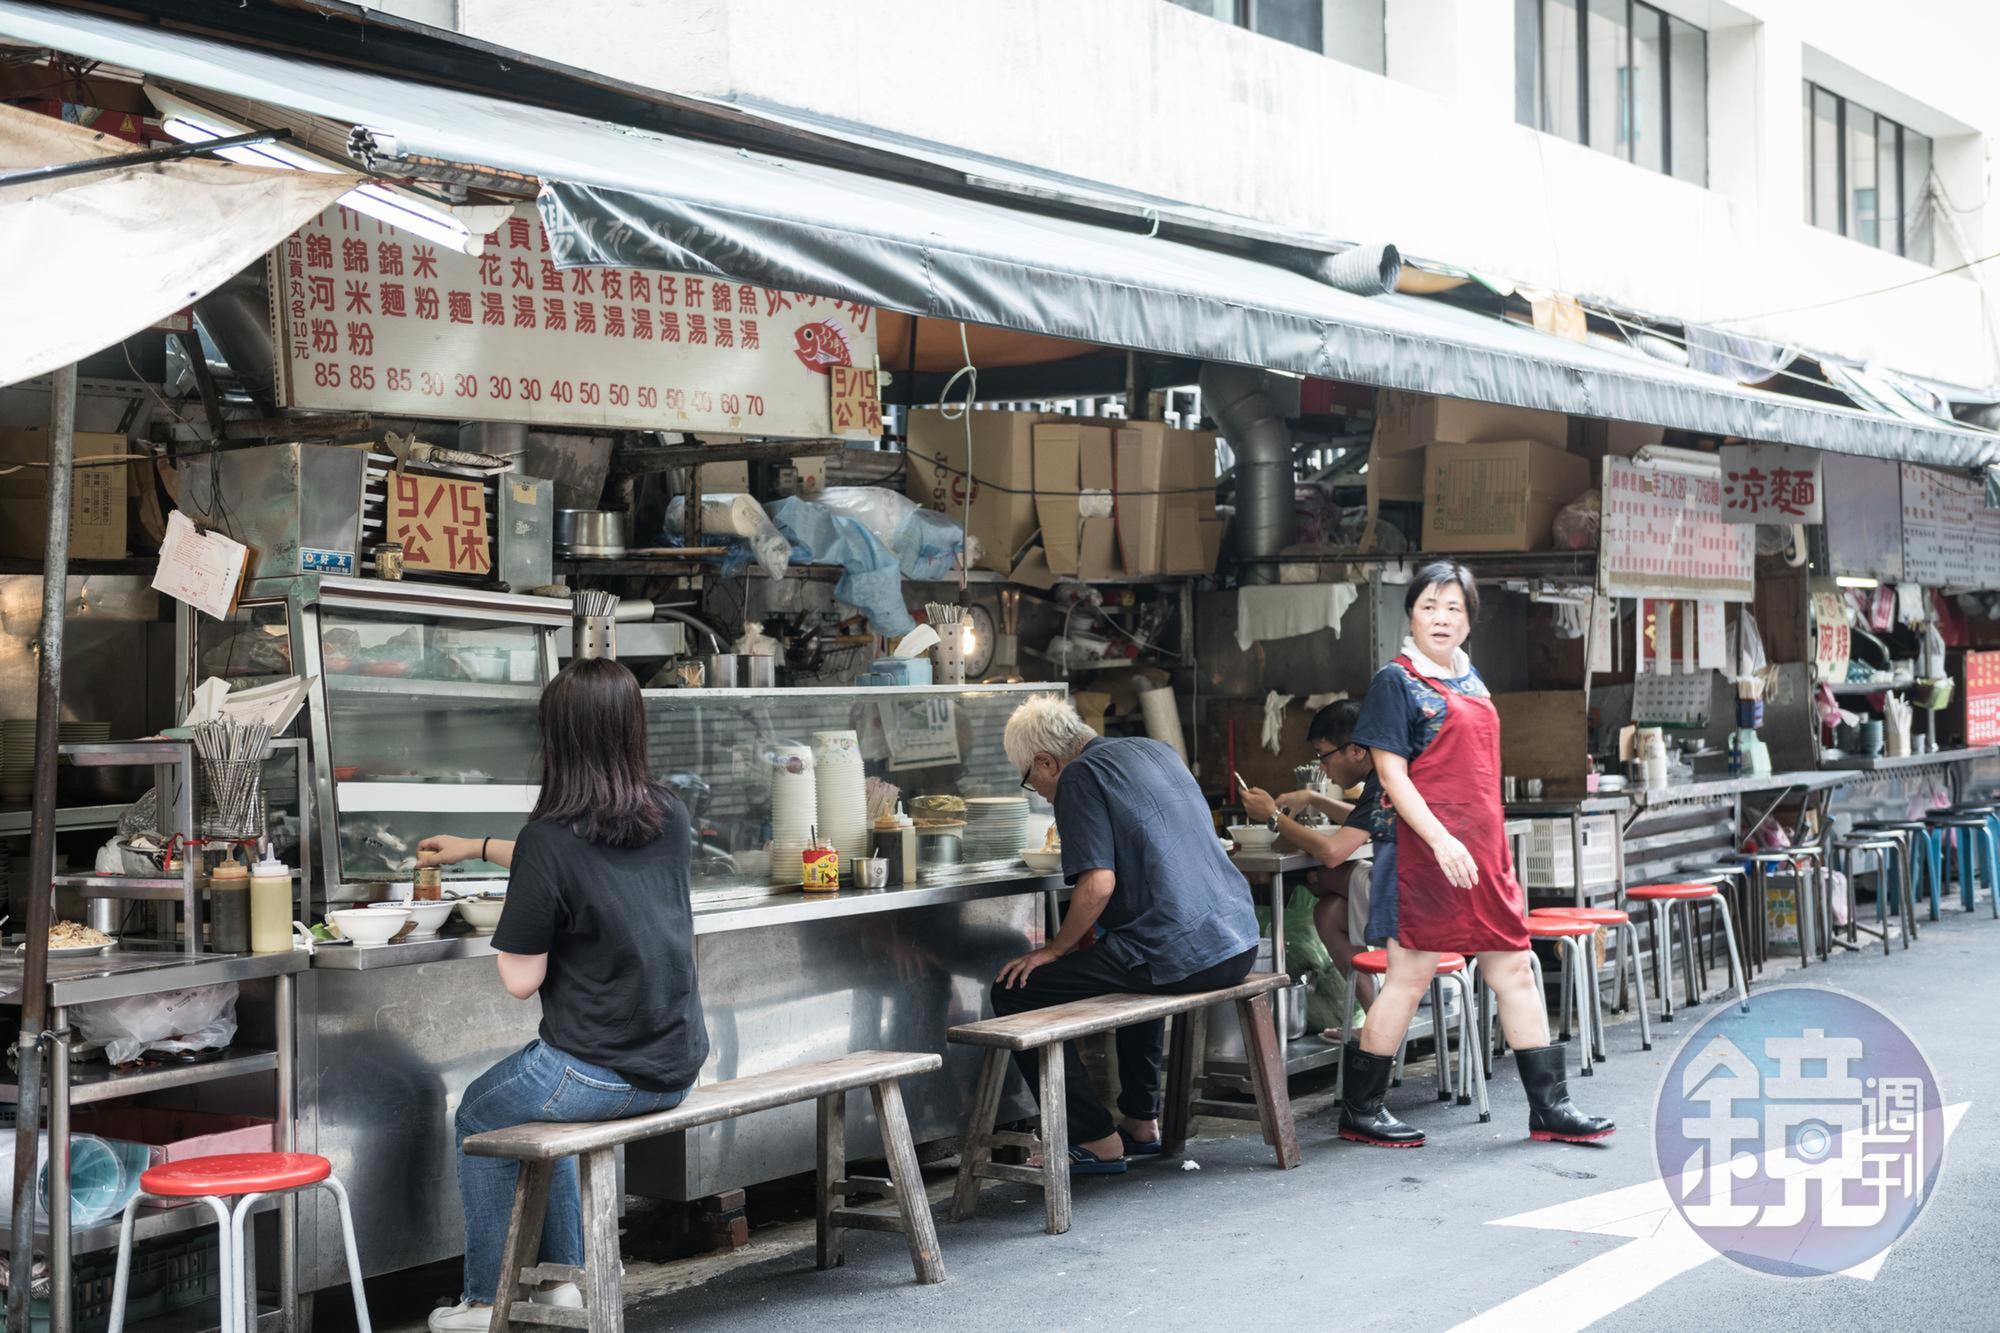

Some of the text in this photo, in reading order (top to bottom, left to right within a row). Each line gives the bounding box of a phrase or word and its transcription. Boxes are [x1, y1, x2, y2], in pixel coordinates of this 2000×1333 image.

[287, 230, 310, 360] 加貢丸各10元
[412, 244, 439, 320] 米粉
[508, 217, 536, 329] 貢丸湯
[539, 221, 567, 331] 蛋湯
[601, 268, 626, 338] 枝湯
[629, 271, 653, 340] 肉湯
[448, 290, 474, 325] 麵
[657, 274, 681, 342] 仔湯
[684, 277, 708, 345] 肝湯
[711, 281, 734, 348] 錦湯
[737, 284, 760, 350] 魚湯
[314, 362, 341, 388] 85
[349, 364, 375, 390] 85
[386, 368, 412, 392] 85
[420, 371, 444, 396] 30
[455, 374, 477, 398] 30
[489, 376, 511, 400] 30
[519, 378, 541, 401] 30
[550, 380, 573, 404] 40
[579, 381, 600, 405] 50
[609, 383, 629, 407] 50
[637, 385, 657, 408] 50
[666, 388, 684, 410] 50
[720, 393, 740, 415] 60
[745, 394, 764, 416] 70
[835, 368, 875, 400] 9/15
[835, 401, 882, 428] 公休
[396, 475, 481, 527] 9/15
[1724, 466, 1814, 516] 涼麵
[397, 523, 490, 571] 公休
